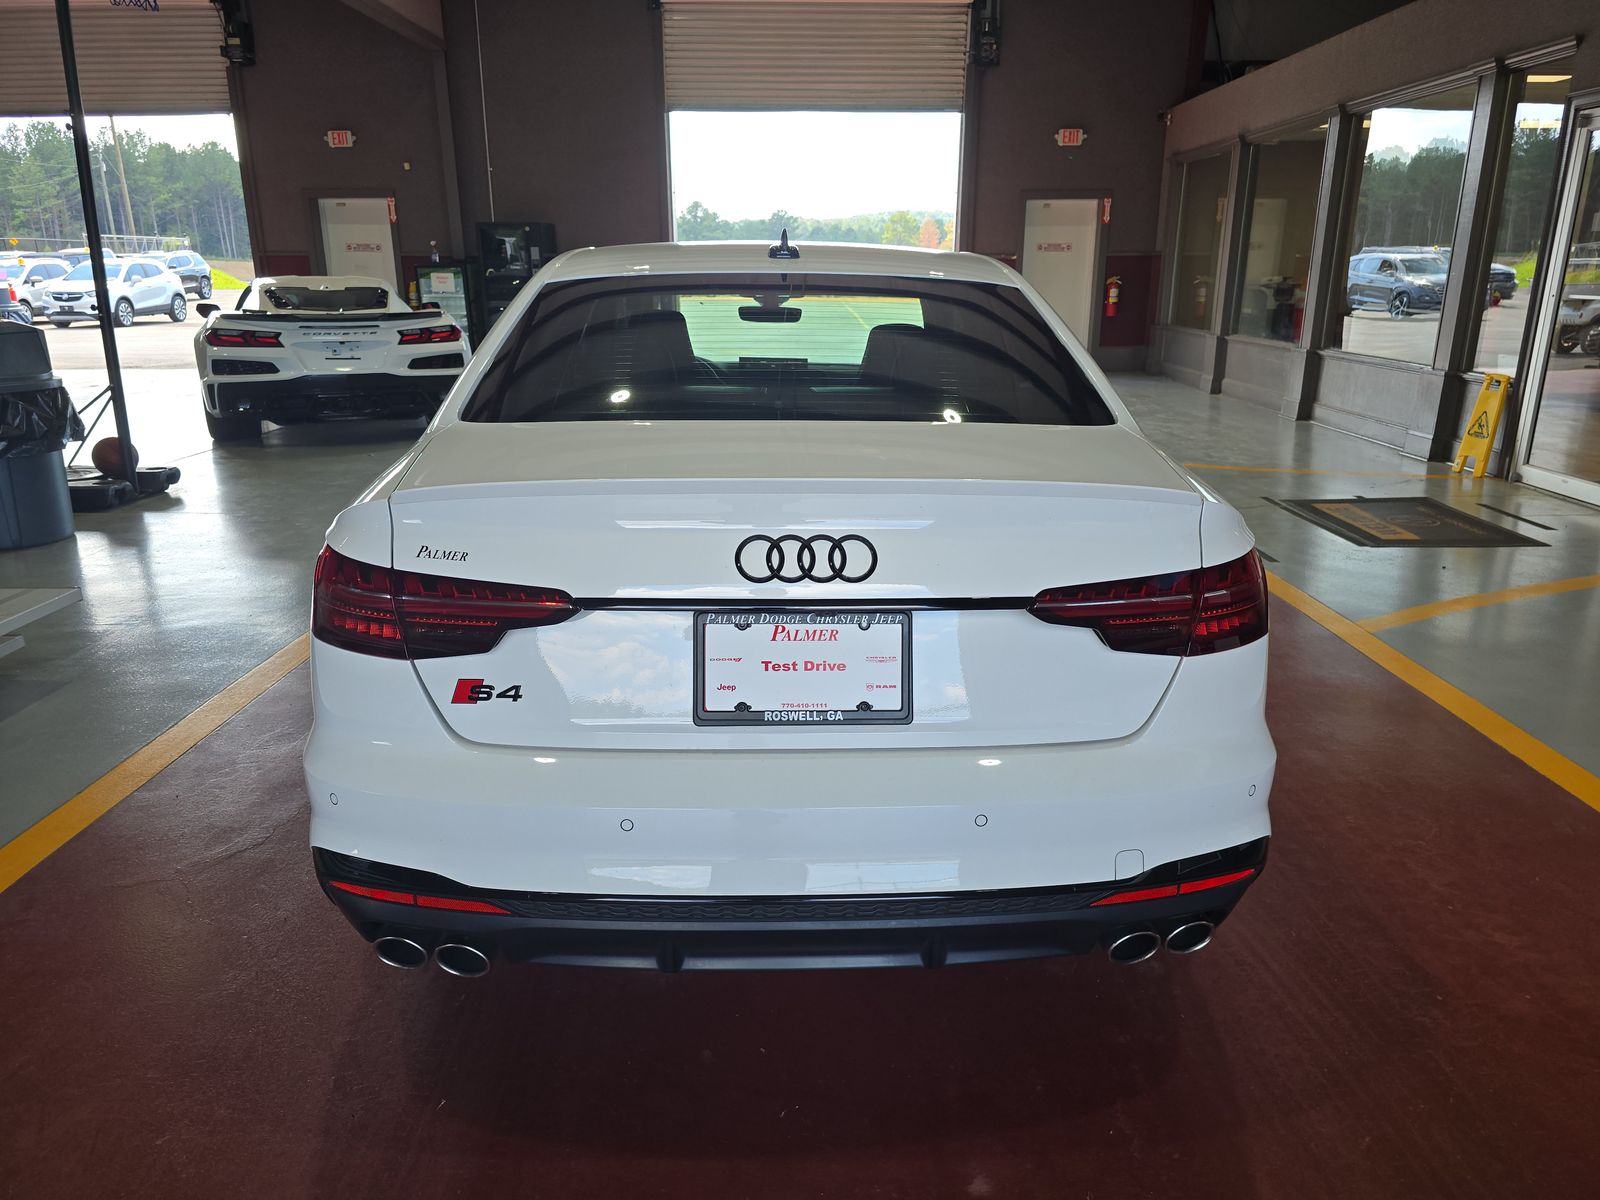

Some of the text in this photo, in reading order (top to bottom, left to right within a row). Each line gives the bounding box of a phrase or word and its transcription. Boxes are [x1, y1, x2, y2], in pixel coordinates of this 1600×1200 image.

[331, 131, 349, 145] EXIT
[1062, 130, 1080, 144] EXIT
[416, 545, 468, 561] PALMER
[706, 612, 903, 624] PALMER DODGE CHRYSLER JEEP
[770, 624, 839, 642] PALMER
[761, 660, 847, 672] Test Drive
[468, 684, 523, 702] S4
[717, 683, 737, 692] Jeep
[764, 711, 844, 721] ROSWELL, GA
